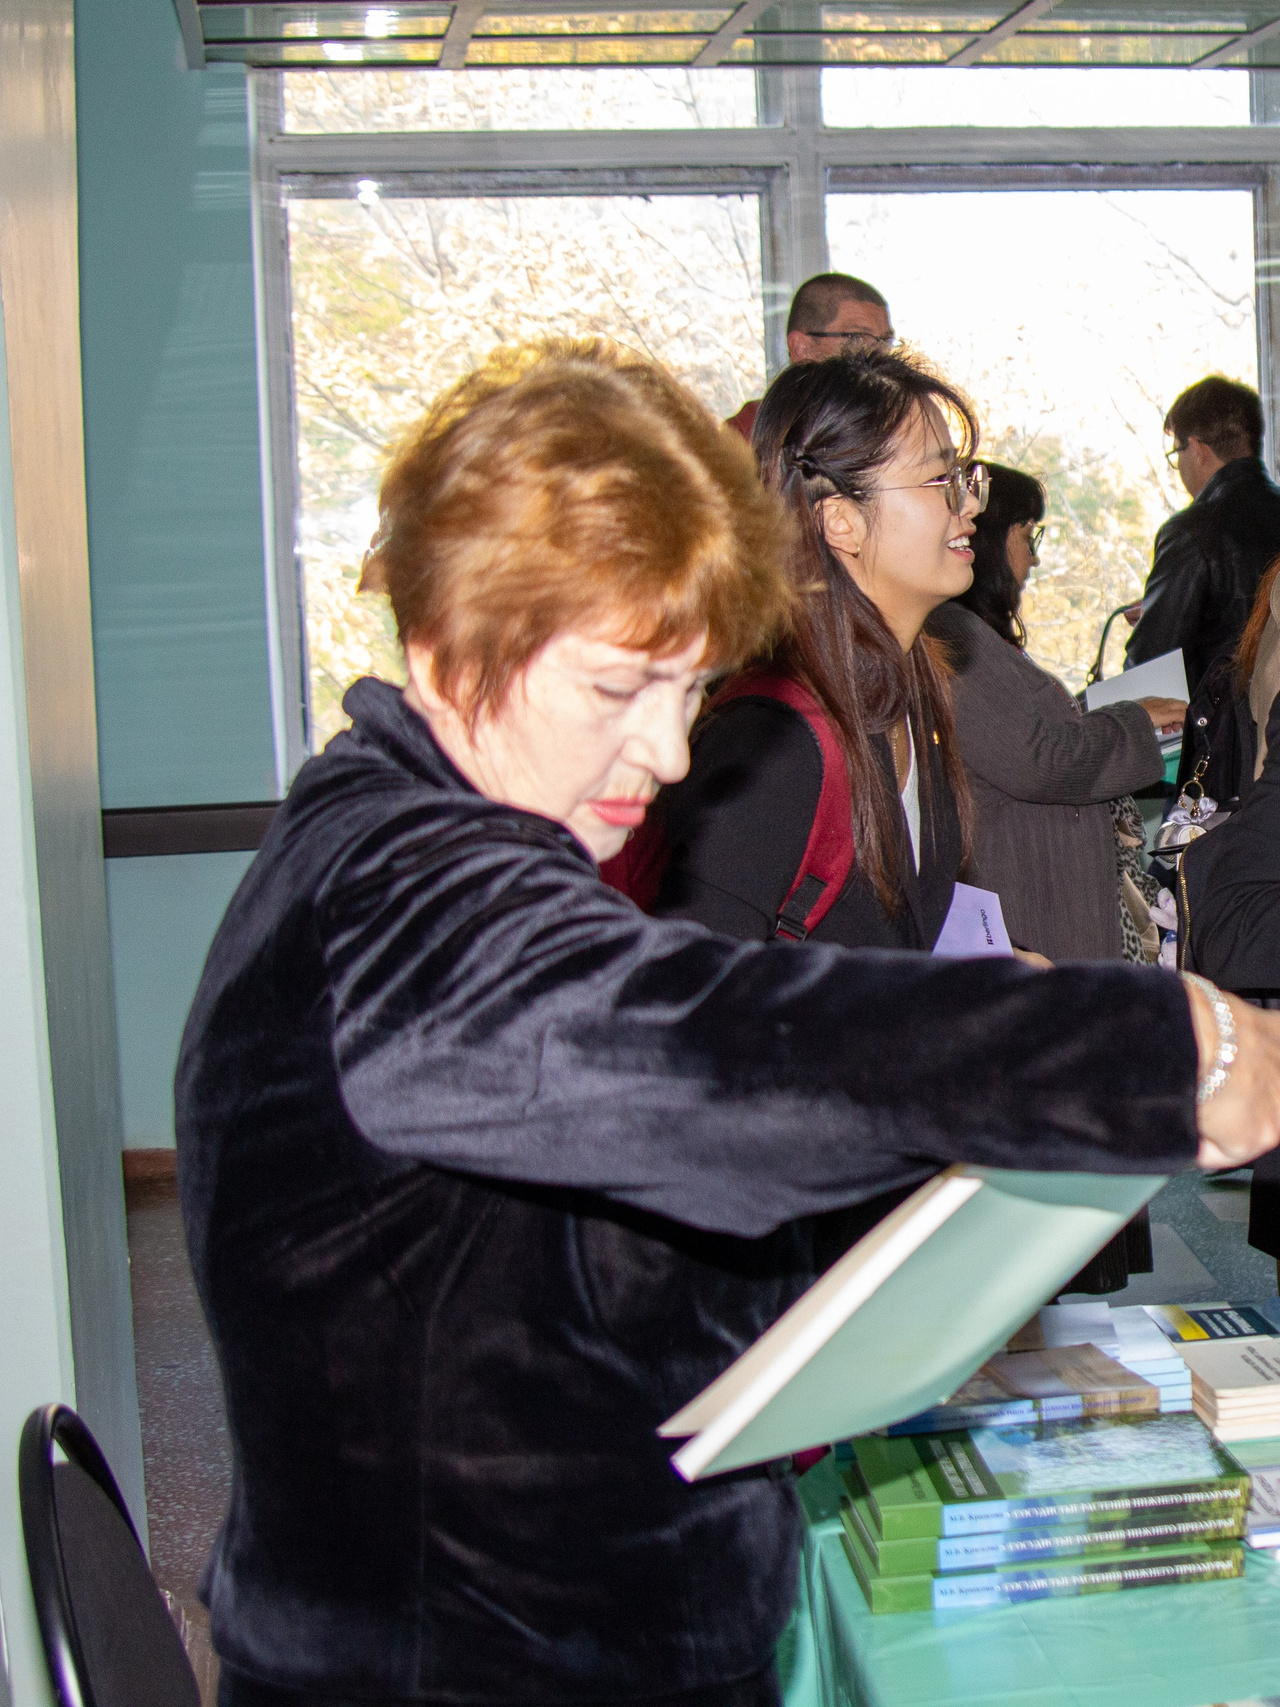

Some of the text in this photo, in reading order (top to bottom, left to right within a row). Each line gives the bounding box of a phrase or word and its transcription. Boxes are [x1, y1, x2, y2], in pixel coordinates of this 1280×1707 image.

[980, 909, 992, 940] berlingo
[1081, 1499, 1131, 1513] РАСТЕНИЯ
[1132, 1494, 1182, 1508] НИЖНЕГО
[1182, 1489, 1241, 1503] ПРИАМУРЬЯ
[1076, 1529, 1126, 1544] РАСТЕНИЯ
[1126, 1524, 1177, 1539] НИЖНЕГО
[1176, 1518, 1235, 1532] ПРИАМУРЬЯ
[1071, 1570, 1122, 1585] РАСТЕНИЯ
[1122, 1565, 1174, 1580] НИЖНЕГО
[1174, 1560, 1233, 1575] ПРИАМУРЬЯ
